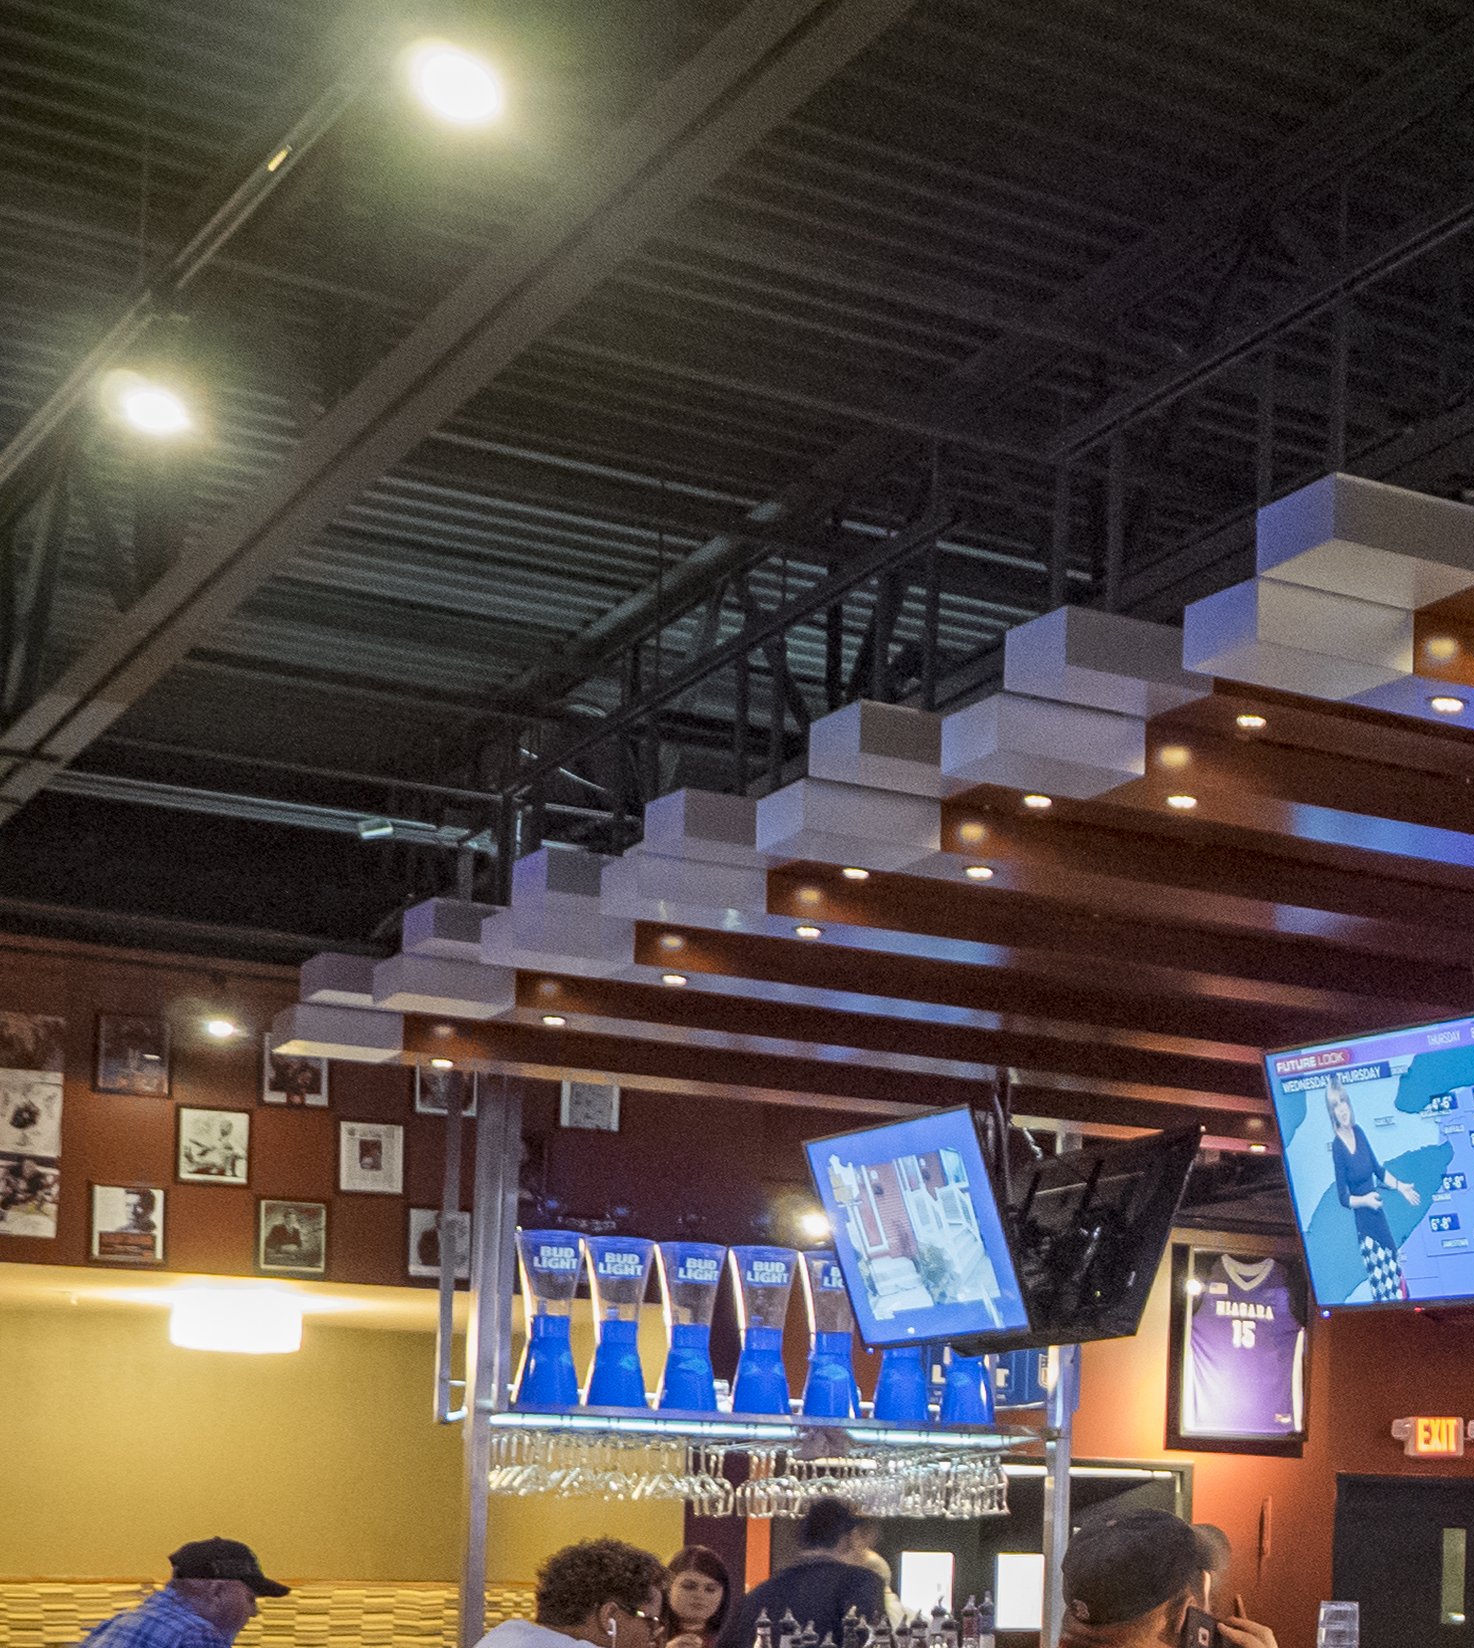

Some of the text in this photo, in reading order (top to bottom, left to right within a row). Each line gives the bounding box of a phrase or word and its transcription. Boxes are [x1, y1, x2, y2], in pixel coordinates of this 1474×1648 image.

[1427, 1030, 1461, 1046] THURSDAY
[1276, 1051, 1345, 1074] FUTURE LOOK
[1282, 1074, 1331, 1093] WEDNESDAY
[1335, 1066, 1382, 1085] THURSDAY
[540, 1245, 576, 1258] BUD
[604, 1251, 640, 1265] BUD
[532, 1255, 579, 1270] LIGHT
[598, 1262, 644, 1277] LIGHT
[685, 1256, 718, 1270] BUD
[752, 1260, 786, 1273] BUD
[677, 1267, 720, 1282] LIGHT
[746, 1270, 790, 1284] LIGHT
[1215, 1300, 1275, 1321] NIAGARA
[1231, 1319, 1257, 1349] 15
[1417, 1418, 1459, 1452] EXIT
